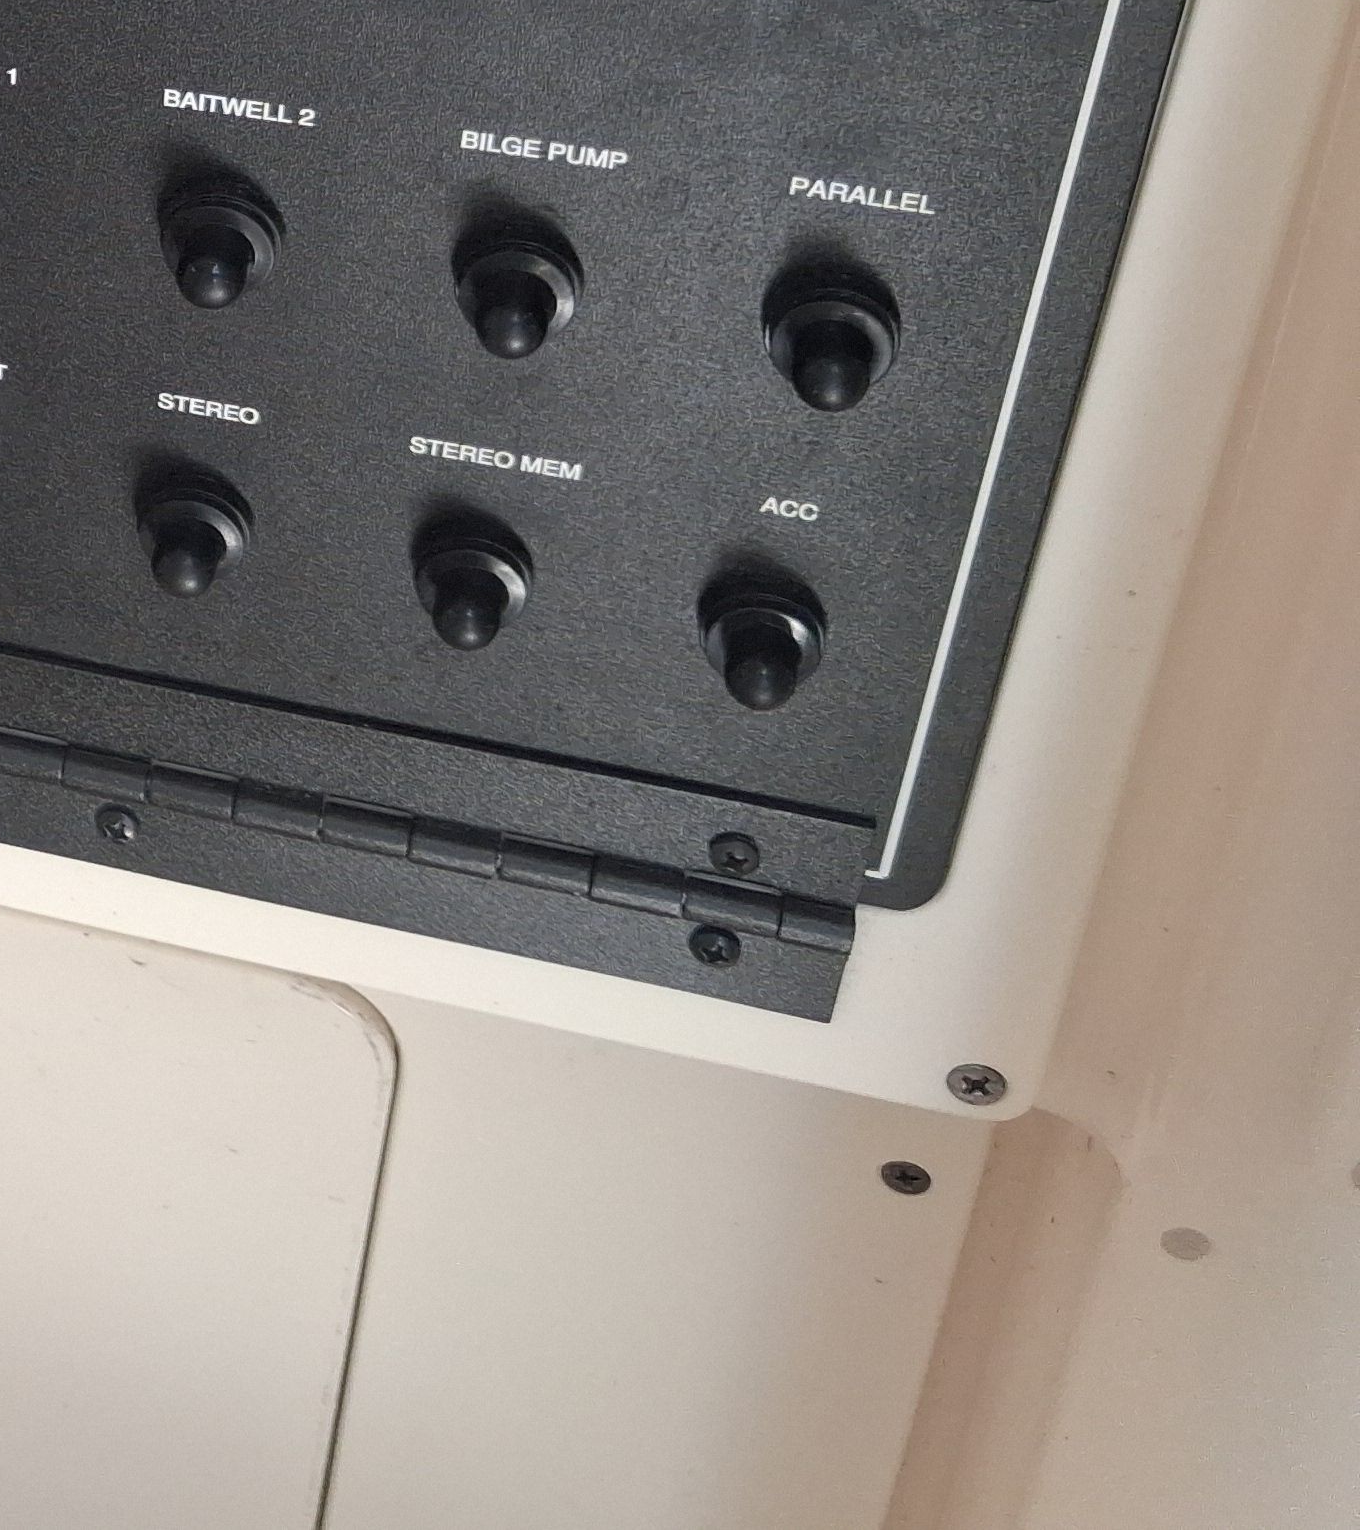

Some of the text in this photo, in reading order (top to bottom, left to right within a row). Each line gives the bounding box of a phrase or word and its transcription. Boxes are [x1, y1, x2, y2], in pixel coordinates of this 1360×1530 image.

[6, 67, 17, 86] 1
[163, 88, 316, 127] BAITWELL 2
[460, 129, 628, 170] BILGE PUMP
[789, 176, 935, 215] PARALLEL
[157, 392, 260, 425] STEREO
[409, 436, 583, 481] STEREO MEM
[759, 496, 820, 521] ACC
